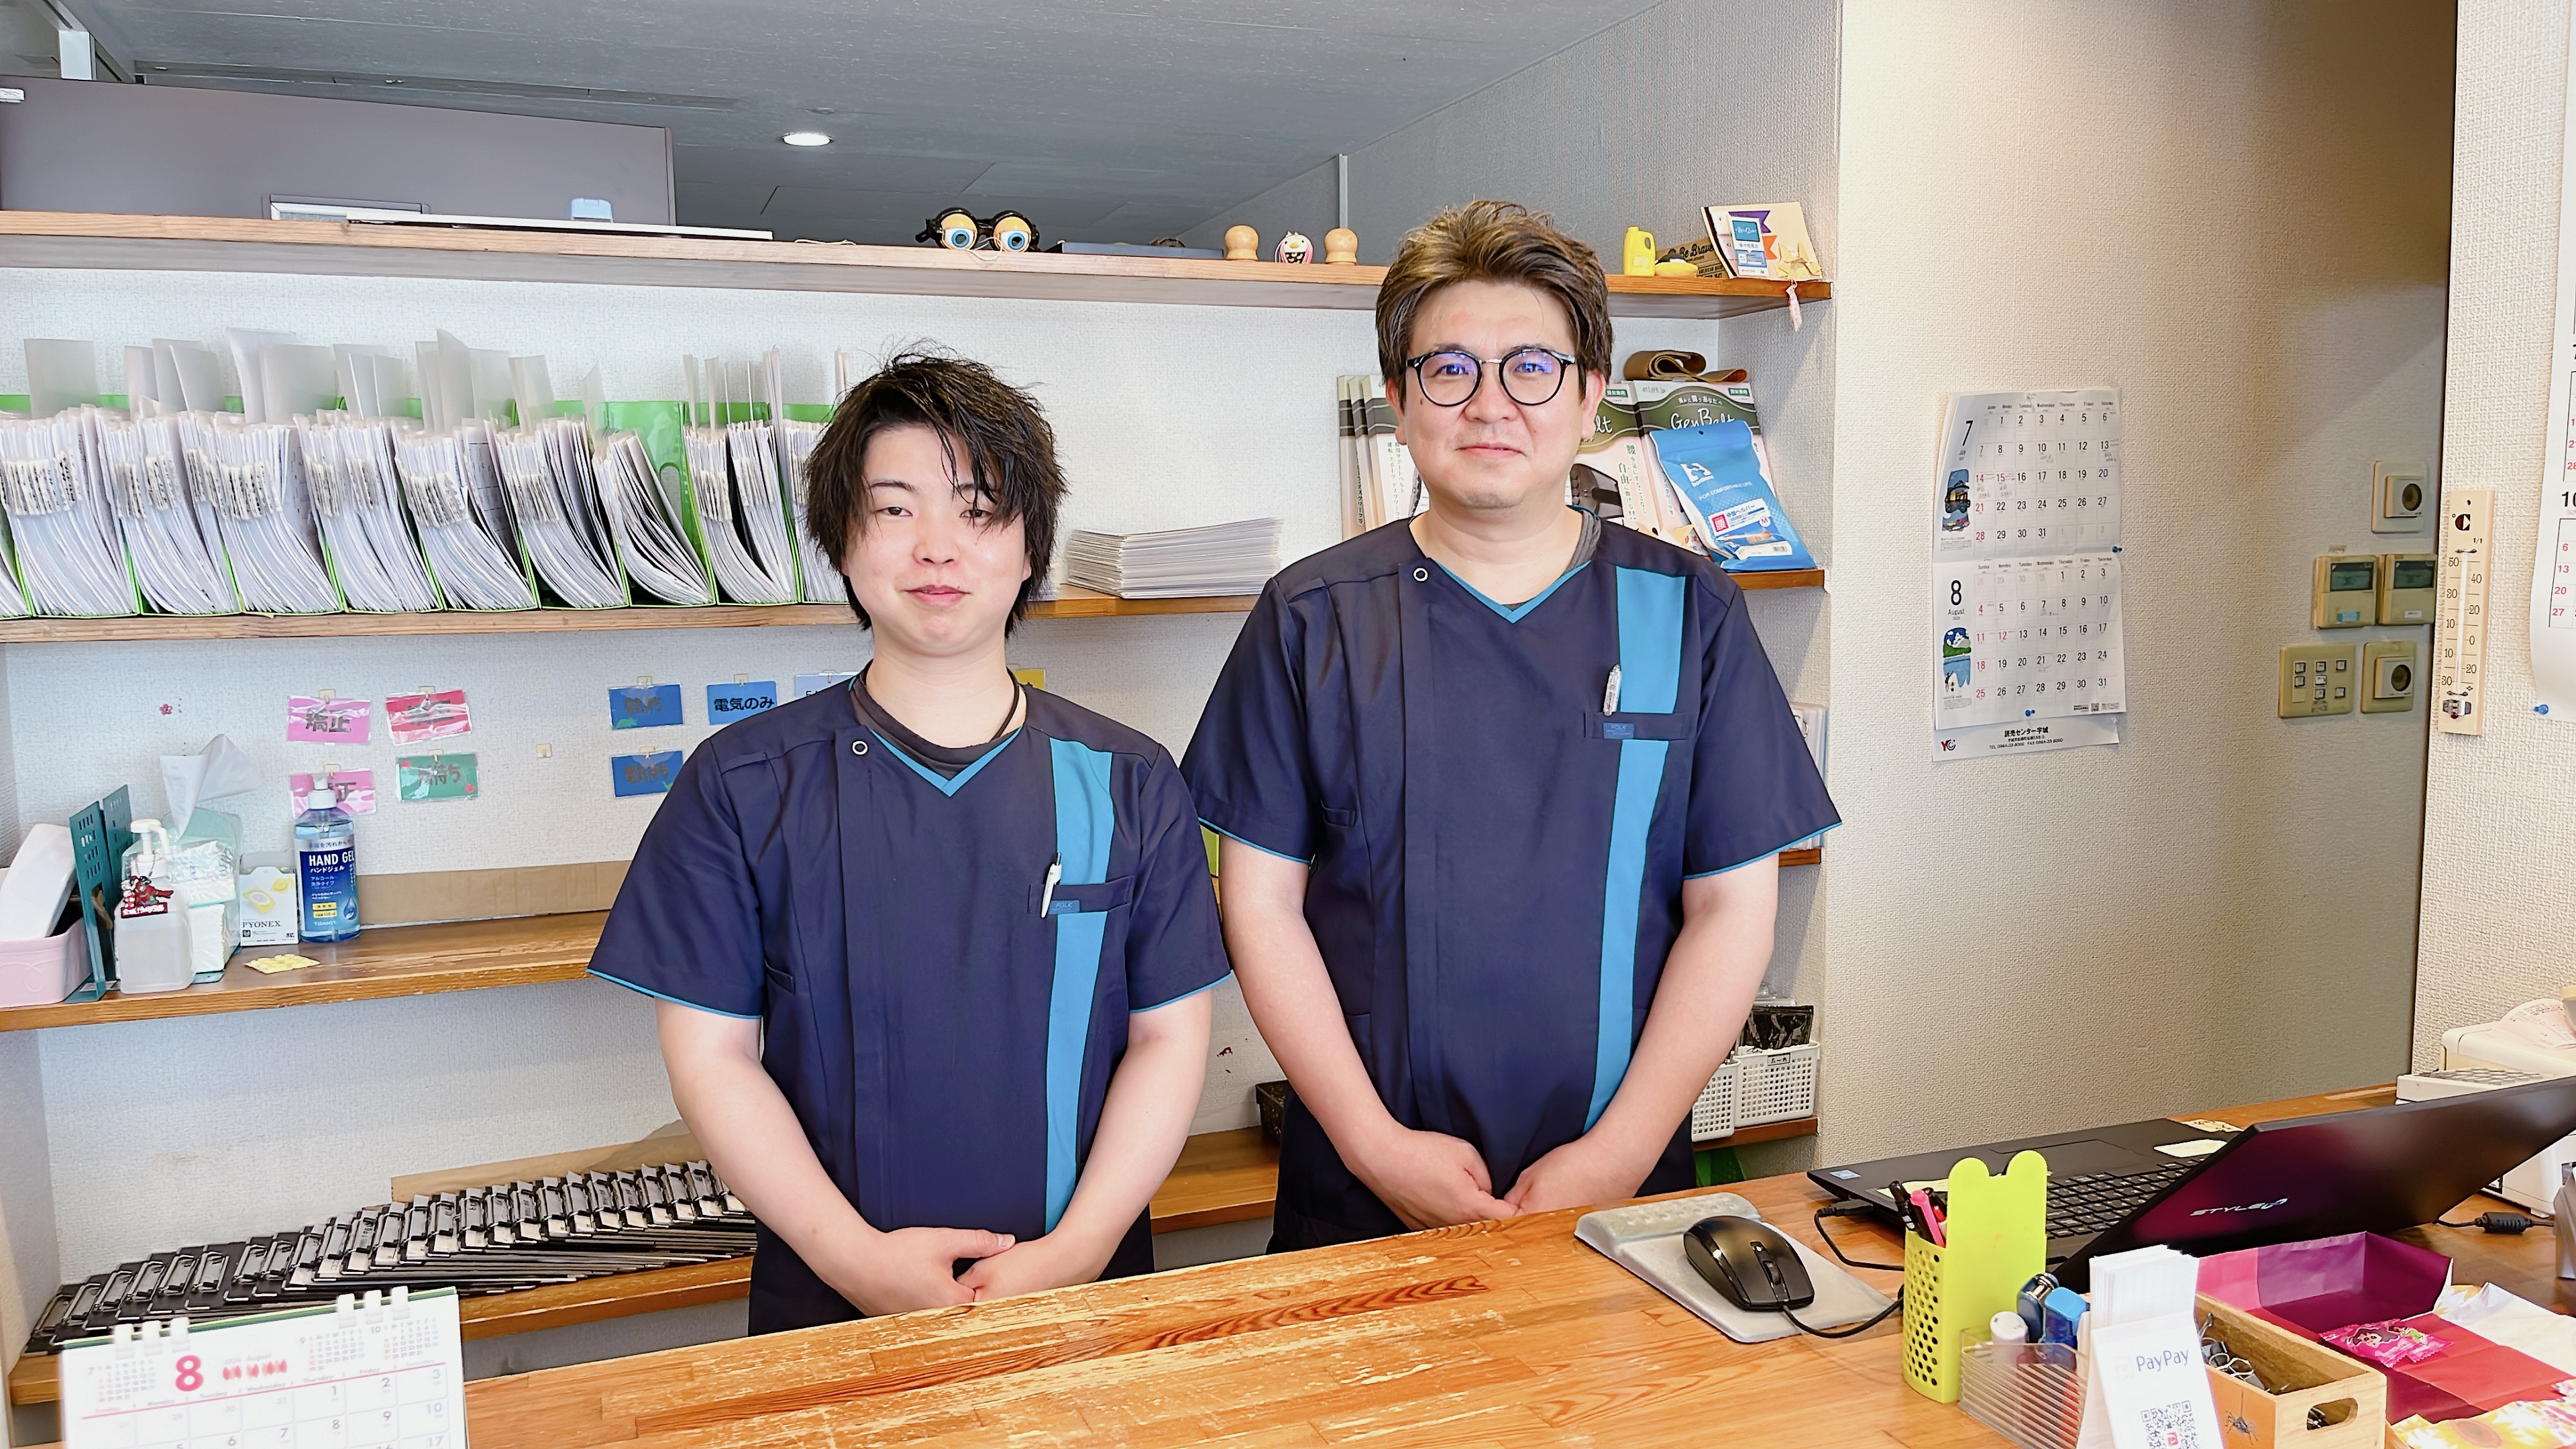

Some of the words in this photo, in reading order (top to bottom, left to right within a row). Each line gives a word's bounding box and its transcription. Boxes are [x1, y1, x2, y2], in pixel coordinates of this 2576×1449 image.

[2019, 416, 2023, 424] 2
[2039, 415, 2043, 423] 3
[2082, 414, 2086, 422] 5
[1962, 420, 1973, 446] 7
[1998, 445, 2002, 453] 8
[2019, 444, 2023, 452] 9
[2038, 443, 2046, 451] 10
[2058, 443, 2065, 451] 11
[2079, 441, 2088, 450] 12
[2101, 441, 2109, 449] 13
[1976, 474, 1984, 482] 14
[1997, 474, 2005, 482] 15
[2018, 473, 2026, 481] 16
[2039, 472, 2046, 480] 17
[2059, 471, 2066, 479] 18
[2078, 470, 2086, 478] 19
[2099, 470, 2108, 478] 20
[1997, 502, 2005, 511] 22
[2038, 500, 2046, 508] 24
[2058, 499, 2066, 507] 25
[2078, 498, 2086, 506] 26
[2098, 497, 2106, 505] 27
[1976, 532, 1984, 540] 28
[1997, 531, 2006, 539] 29
[2018, 529, 2027, 537] 30
[2563, 543, 2568, 551] 6
[2449, 557, 2459, 566] 50
[2081, 570, 2085, 578] 2
[2102, 568, 2105, 576] 3
[2558, 565, 2569, 573] 13
[2471, 574, 2482, 584] 40
[1951, 580, 1962, 606] 8
[2447, 589, 2457, 598] 30
[2555, 586, 2567, 594] 20
[1979, 605, 1983, 613] 4
[2000, 604, 2003, 612] 5
[2082, 598, 2086, 606] 9
[2100, 596, 2108, 604] 10
[2469, 605, 2479, 614] 20
[2447, 619, 2455, 628] 10
[1977, 633, 1984, 641] 11
[1999, 632, 2006, 640] 12
[2020, 630, 2027, 638] 13
[2059, 627, 2067, 635] 15
[2099, 623, 2106, 631] 17
[2469, 636, 2475, 645] 0
[2445, 649, 2453, 657] 10
[1977, 661, 1985, 669] 18
[1998, 659, 2006, 667] 19
[2037, 656, 2045, 664] 21
[2057, 654, 2065, 662] 22
[2098, 651, 2106, 659] 24
[2466, 664, 2477, 674] 20
[2442, 676, 2453, 686] 30
[1976, 690, 1985, 698] 25
[1998, 688, 2006, 696] 26
[2017, 686, 2025, 694] 27
[2037, 684, 2045, 692] 28
[2057, 682, 2065, 690] 29
[2077, 680, 2086, 688] 30
[2098, 678, 2106, 686] 31
[714, 696, 774, 712] 電気のみ
[309, 854, 338, 867] HAND
[342, 851, 354, 863] GEL
[310, 865, 345, 873] ハンドジェル
[370, 1326, 381, 1334] 10
[2136, 1350, 2188, 1371] PayPay
[175, 1355, 204, 1391] 8
[331, 1386, 337, 1395] 1
[382, 1377, 390, 1388] 2
[433, 1368, 441, 1379] 3
[228, 1436, 237, 1446] 6
[280, 1428, 288, 1438] 7
[333, 1419, 341, 1430] 8
[383, 1411, 392, 1421] 9
[426, 1402, 443, 1413] 10
[427, 1436, 443, 1448] 17
